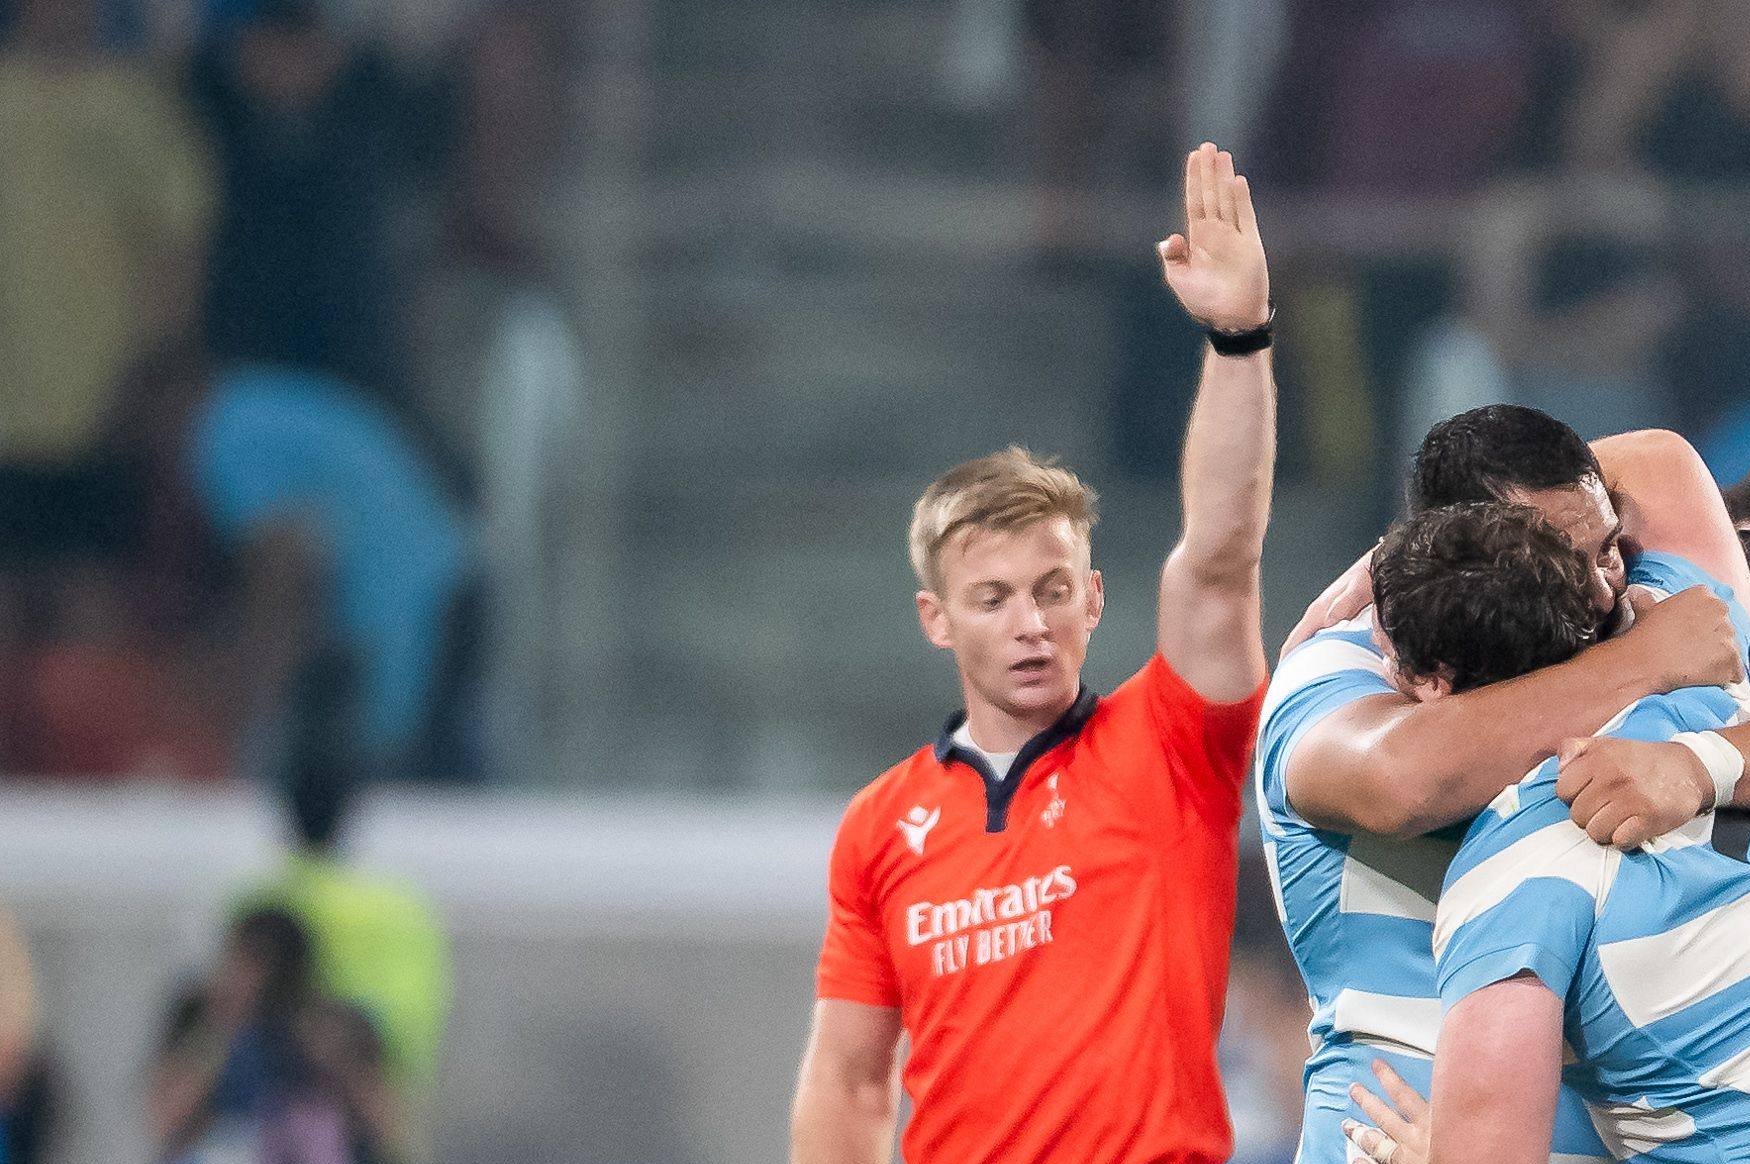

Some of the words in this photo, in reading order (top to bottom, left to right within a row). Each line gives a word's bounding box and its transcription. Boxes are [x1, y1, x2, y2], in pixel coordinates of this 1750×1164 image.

[906, 864, 1077, 946] Emirates
[932, 935, 970, 977] FLY
[975, 909, 1053, 966] BETTER
